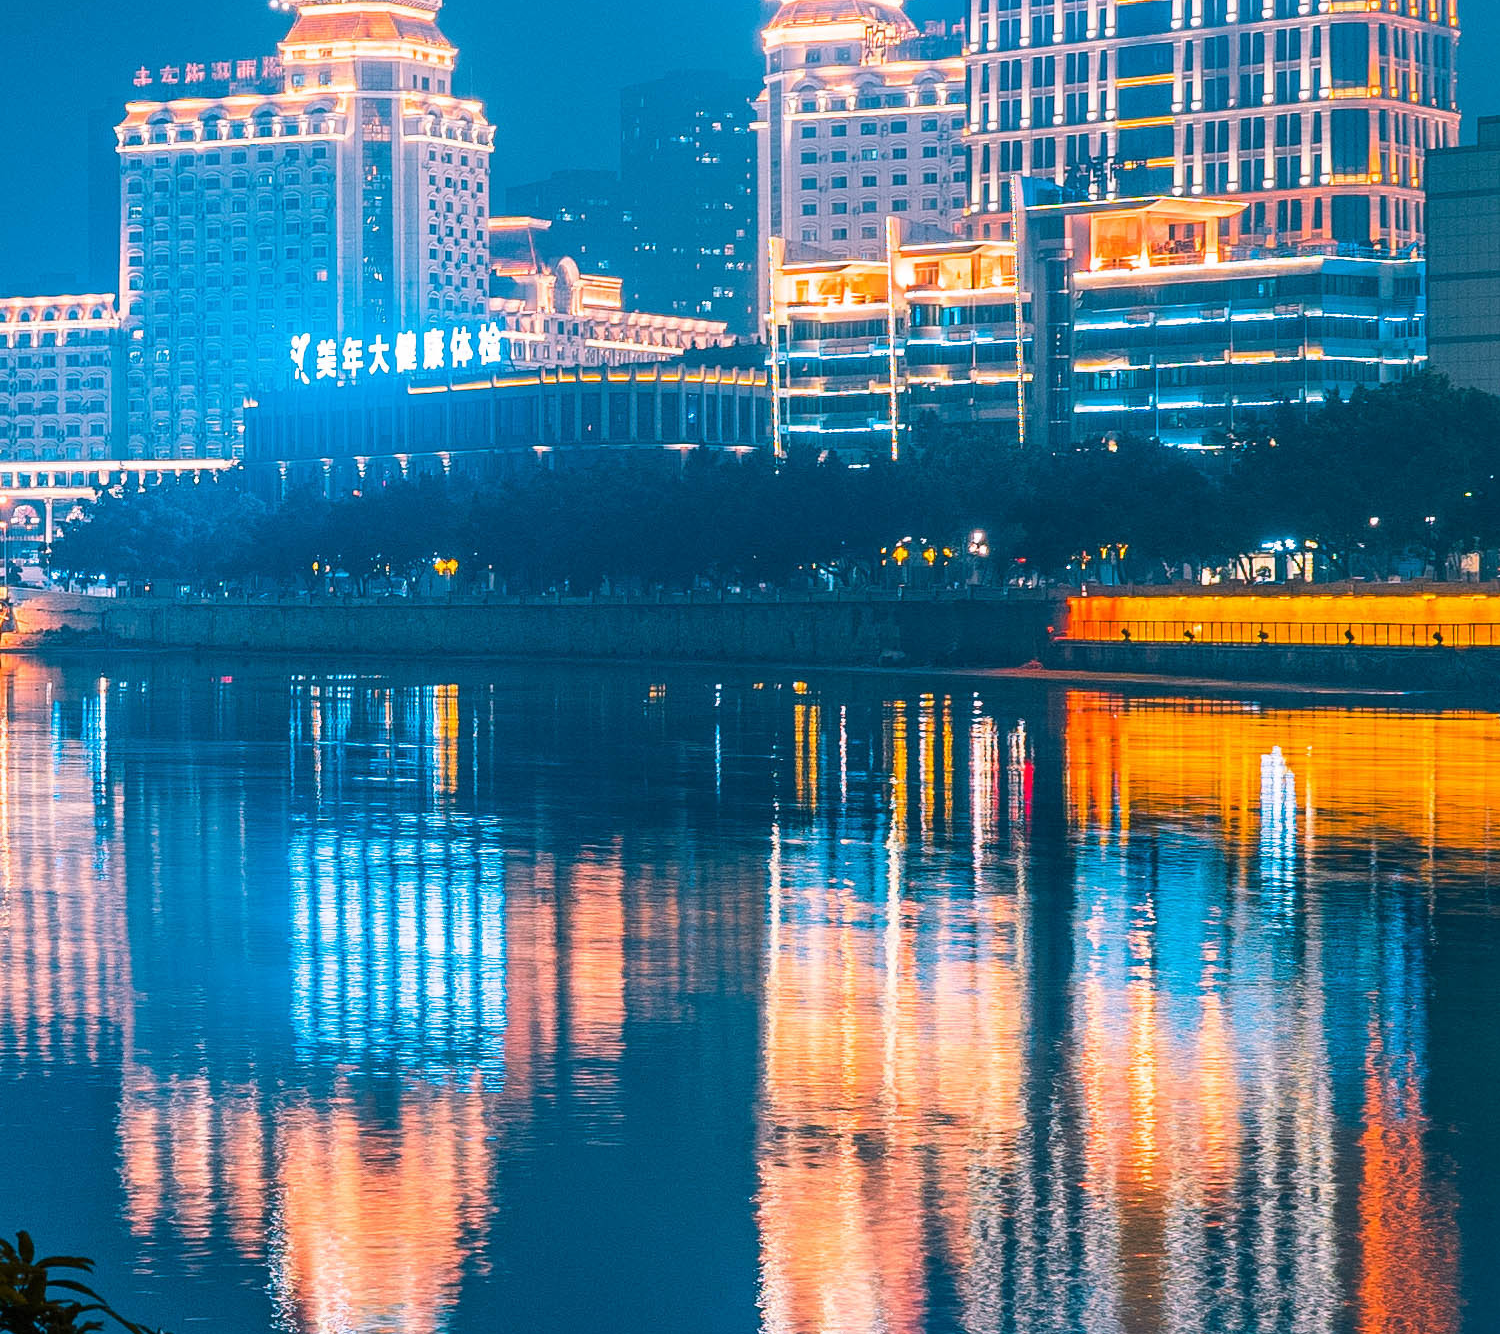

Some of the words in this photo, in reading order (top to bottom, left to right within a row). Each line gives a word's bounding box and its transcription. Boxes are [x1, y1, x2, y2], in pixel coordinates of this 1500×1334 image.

[316, 321, 501, 380] 美年大健康体检
